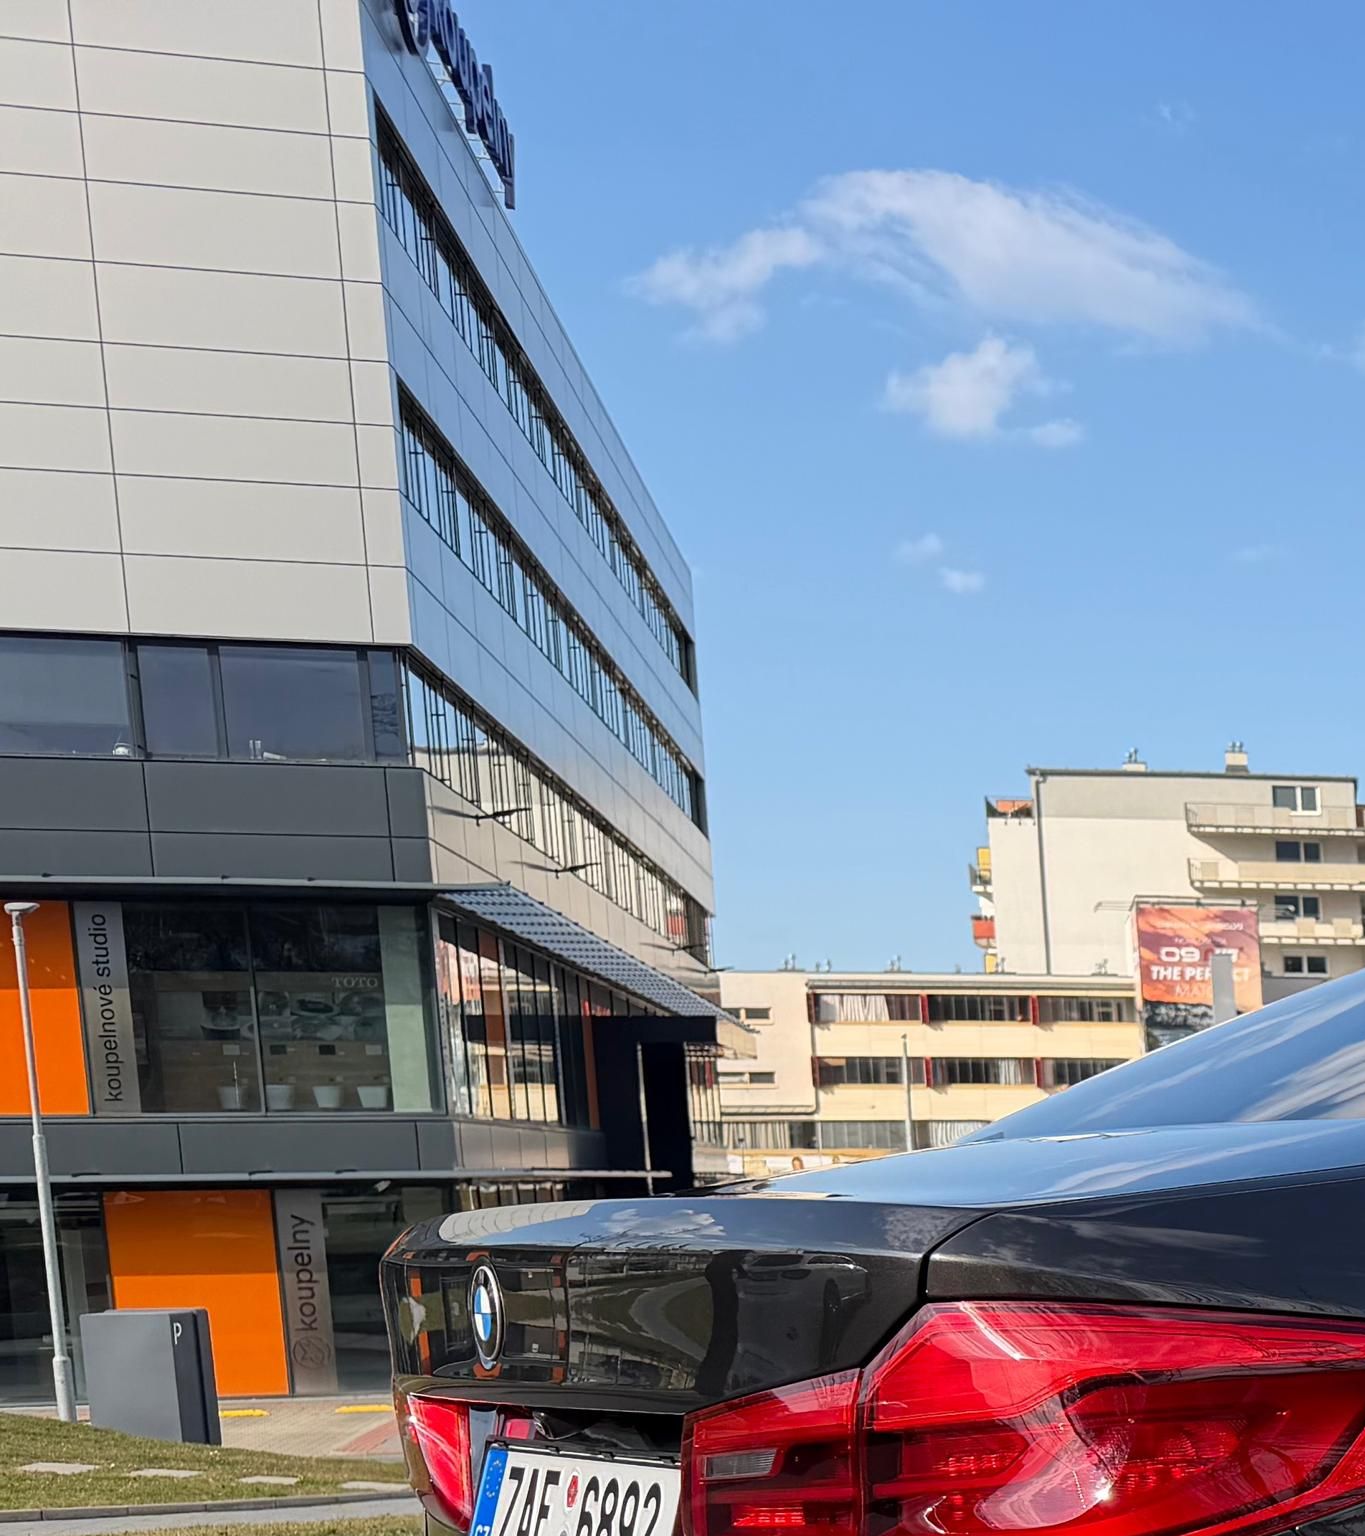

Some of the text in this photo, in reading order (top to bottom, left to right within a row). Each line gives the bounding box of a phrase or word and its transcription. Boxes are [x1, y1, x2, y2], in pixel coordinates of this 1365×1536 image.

[331, 977, 378, 989] TOTO
[1150, 965, 1251, 983] THE PERCT
[88, 913, 125, 1102] koupelnové studio
[287, 1213, 321, 1332] koupelny
[173, 1322, 182, 1345] P
